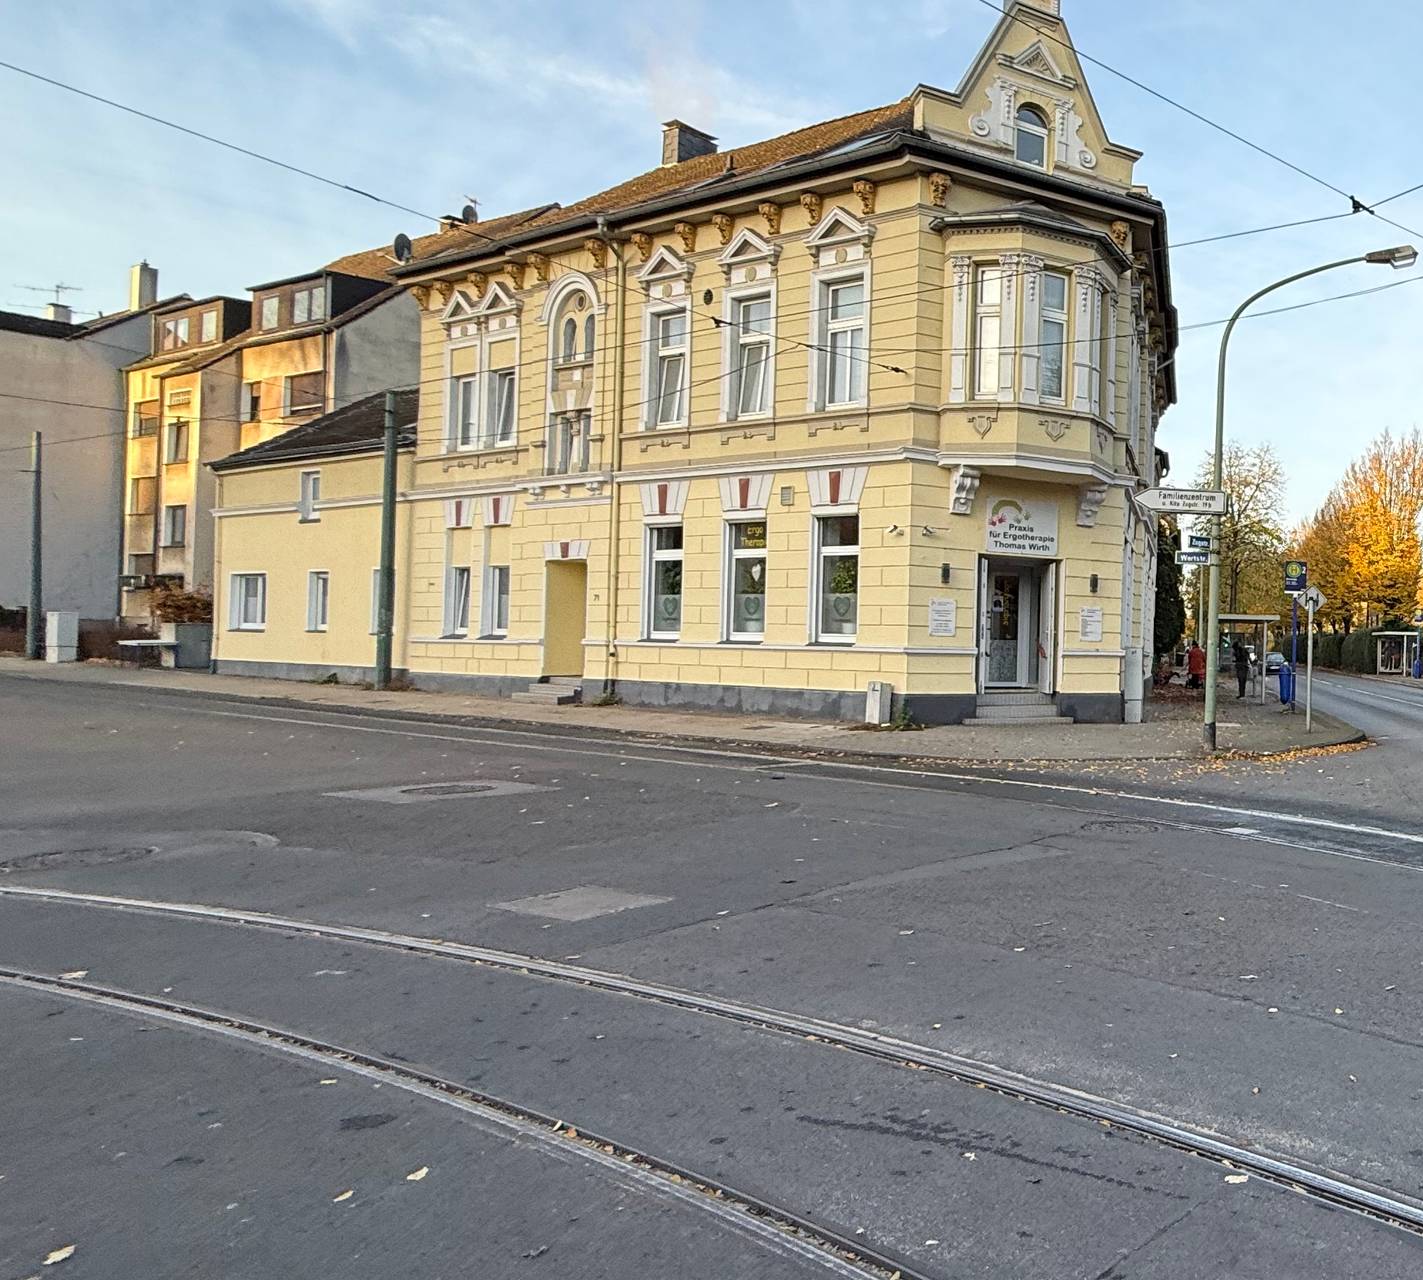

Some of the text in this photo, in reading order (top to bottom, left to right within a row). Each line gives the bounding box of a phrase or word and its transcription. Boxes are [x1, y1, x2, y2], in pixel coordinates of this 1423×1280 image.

[1158, 491, 1216, 502] Familienzentrum
[1009, 523, 1034, 533] Praxis
[989, 530, 1055, 543] für Ergotherapie
[993, 540, 1050, 551] Thomas Wirth
[1302, 566, 1306, 574] 2
